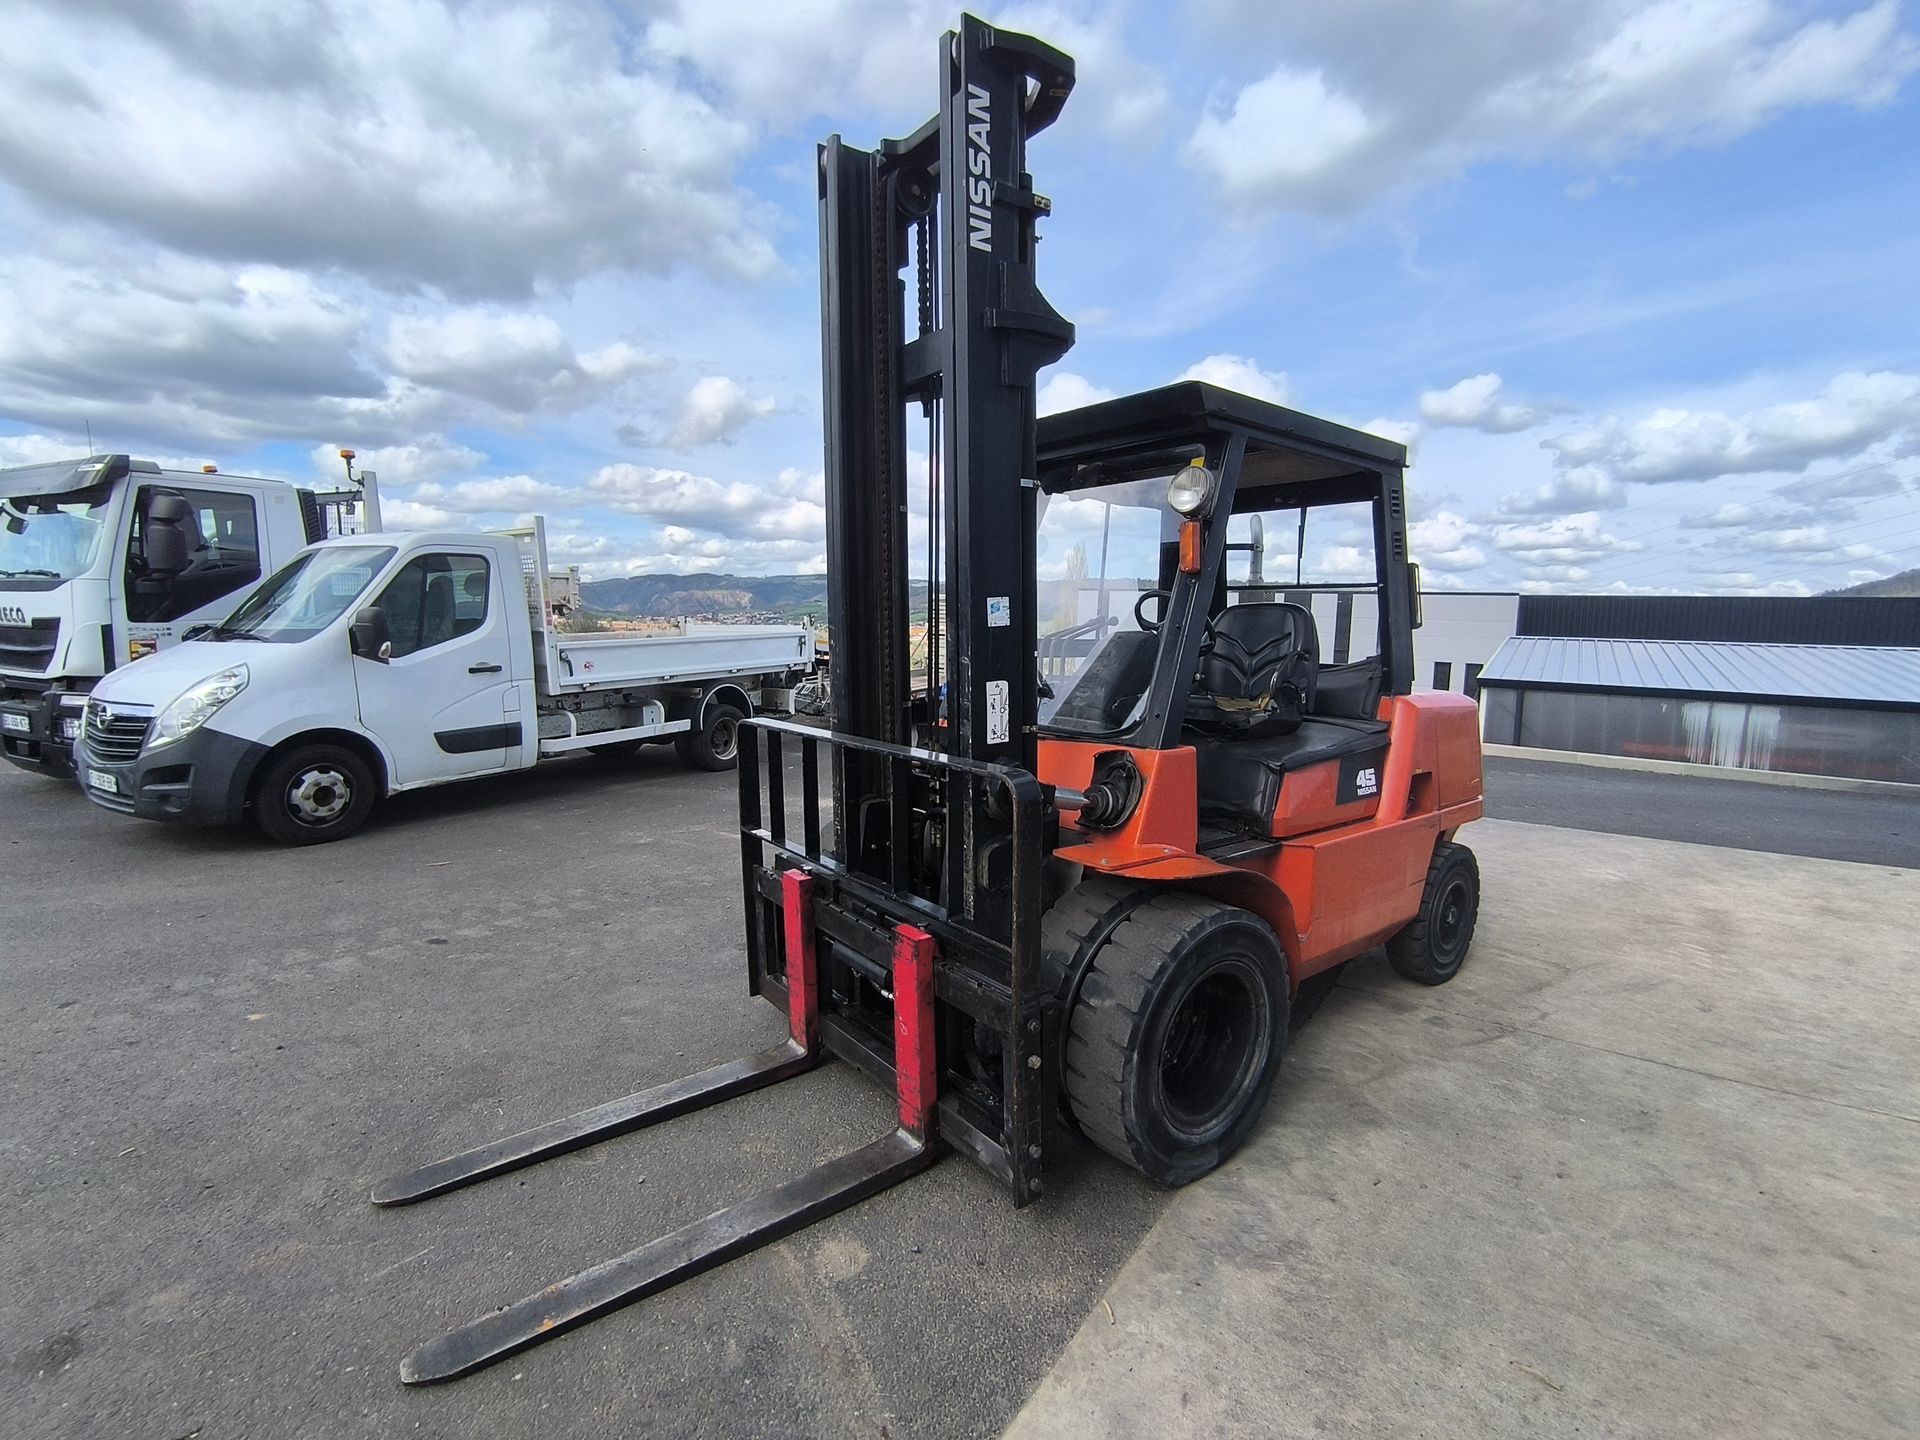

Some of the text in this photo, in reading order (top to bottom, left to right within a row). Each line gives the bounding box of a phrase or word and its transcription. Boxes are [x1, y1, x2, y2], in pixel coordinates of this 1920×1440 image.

[967, 83, 992, 252] NISSAN
[1356, 767, 1376, 787] 45
[1357, 785, 1377, 796] NISSAN
